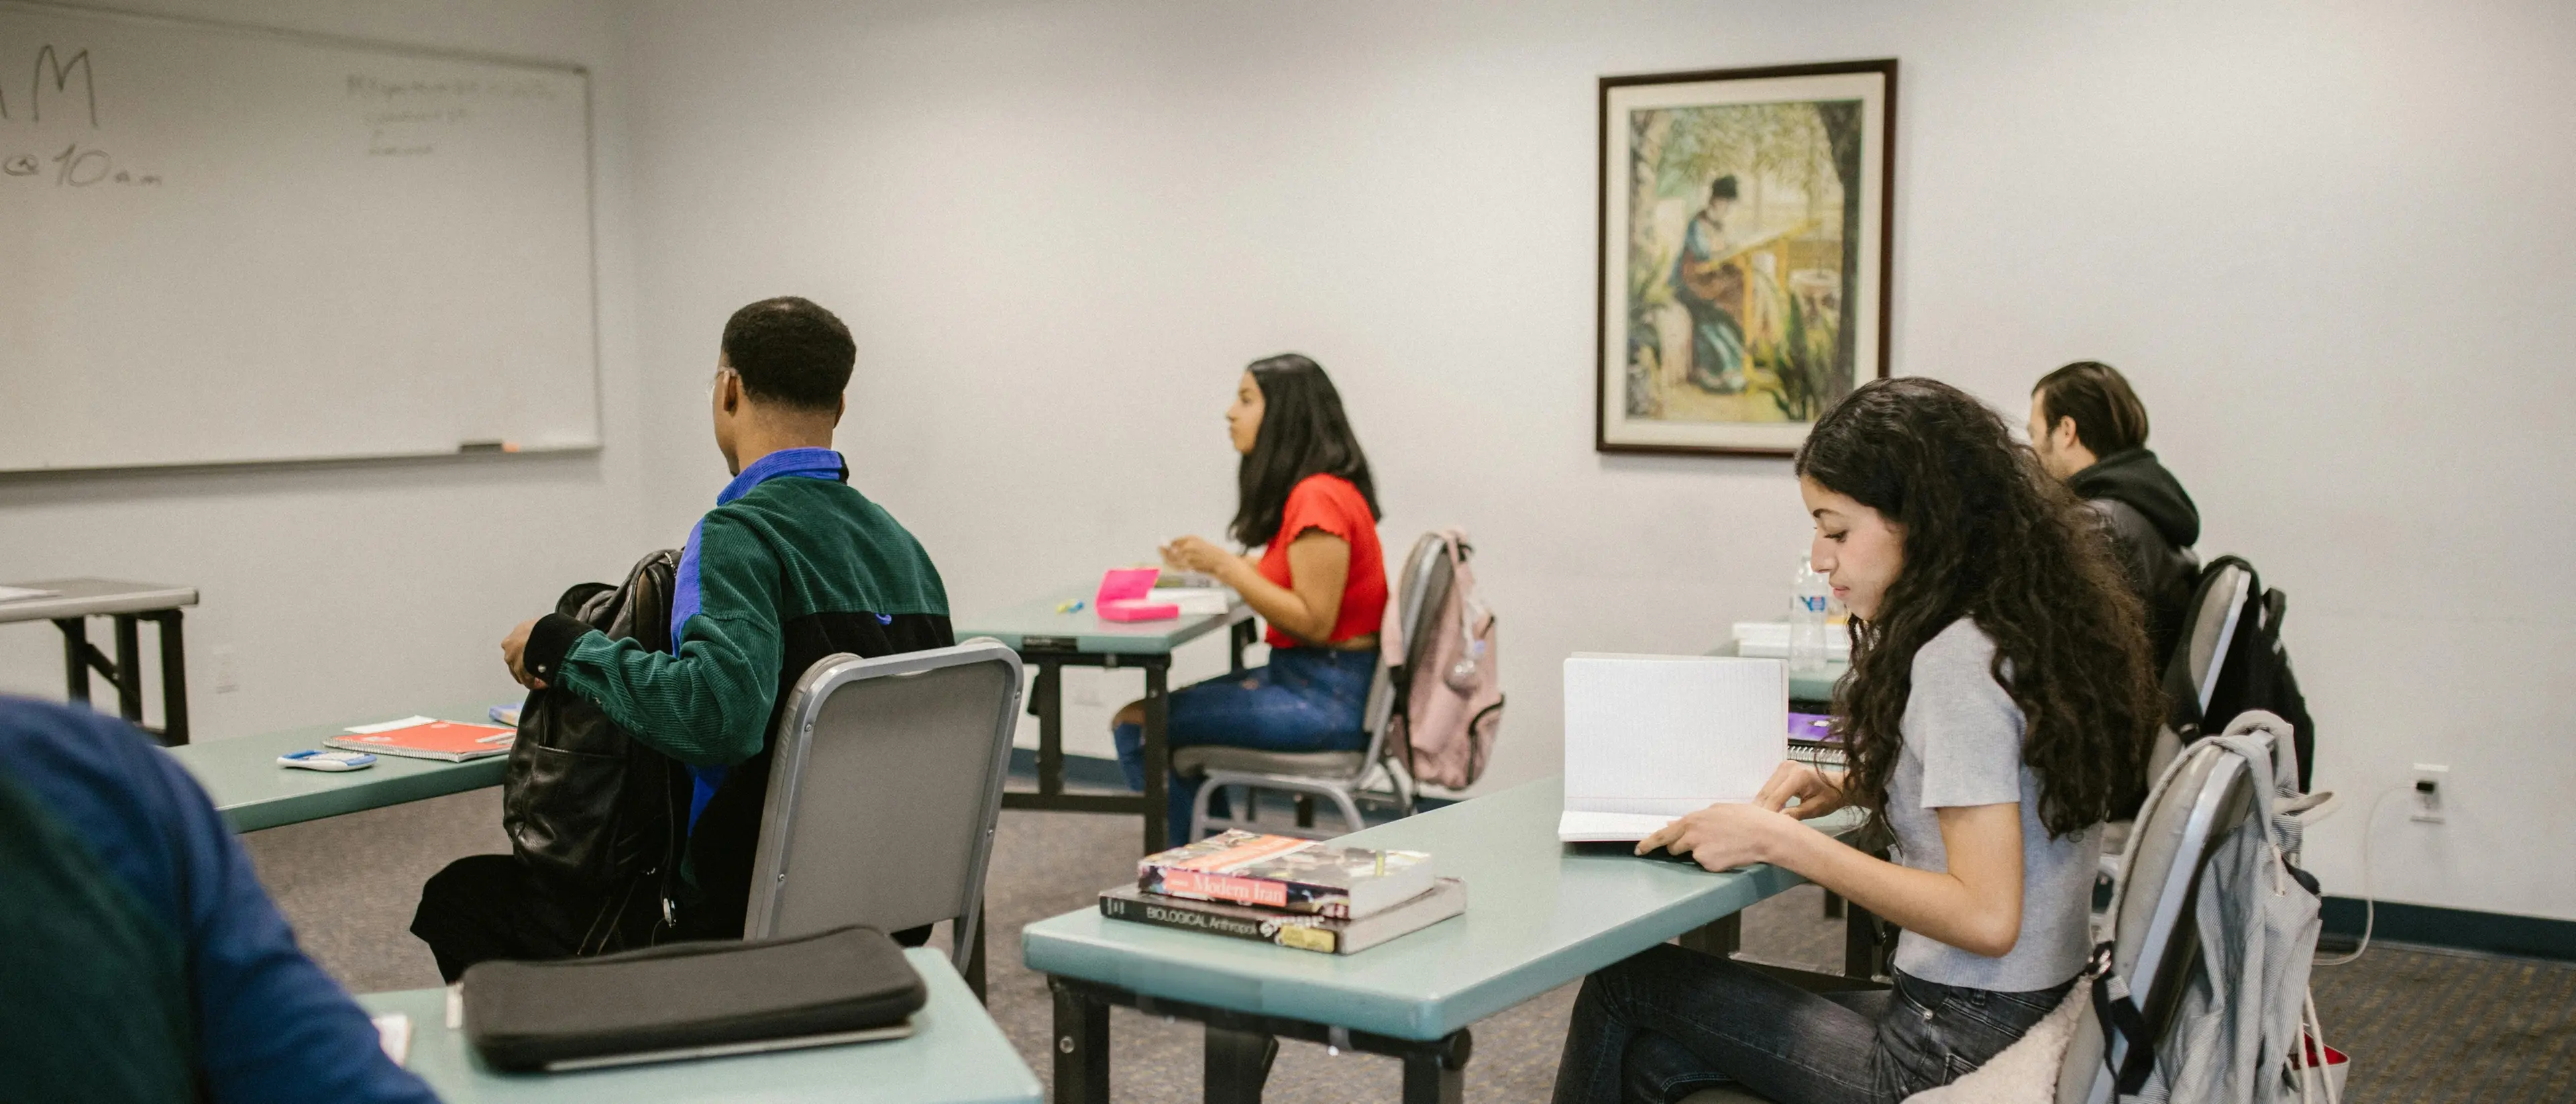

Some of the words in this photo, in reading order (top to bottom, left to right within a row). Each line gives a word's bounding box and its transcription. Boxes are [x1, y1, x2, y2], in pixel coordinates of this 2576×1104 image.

[0, 44, 98, 128] M
[3, 154, 39, 177] @
[1194, 875, 1250, 899] Modern
[1254, 883, 1283, 903] Iran
[1146, 907, 1208, 927] BIOLOGICAL
